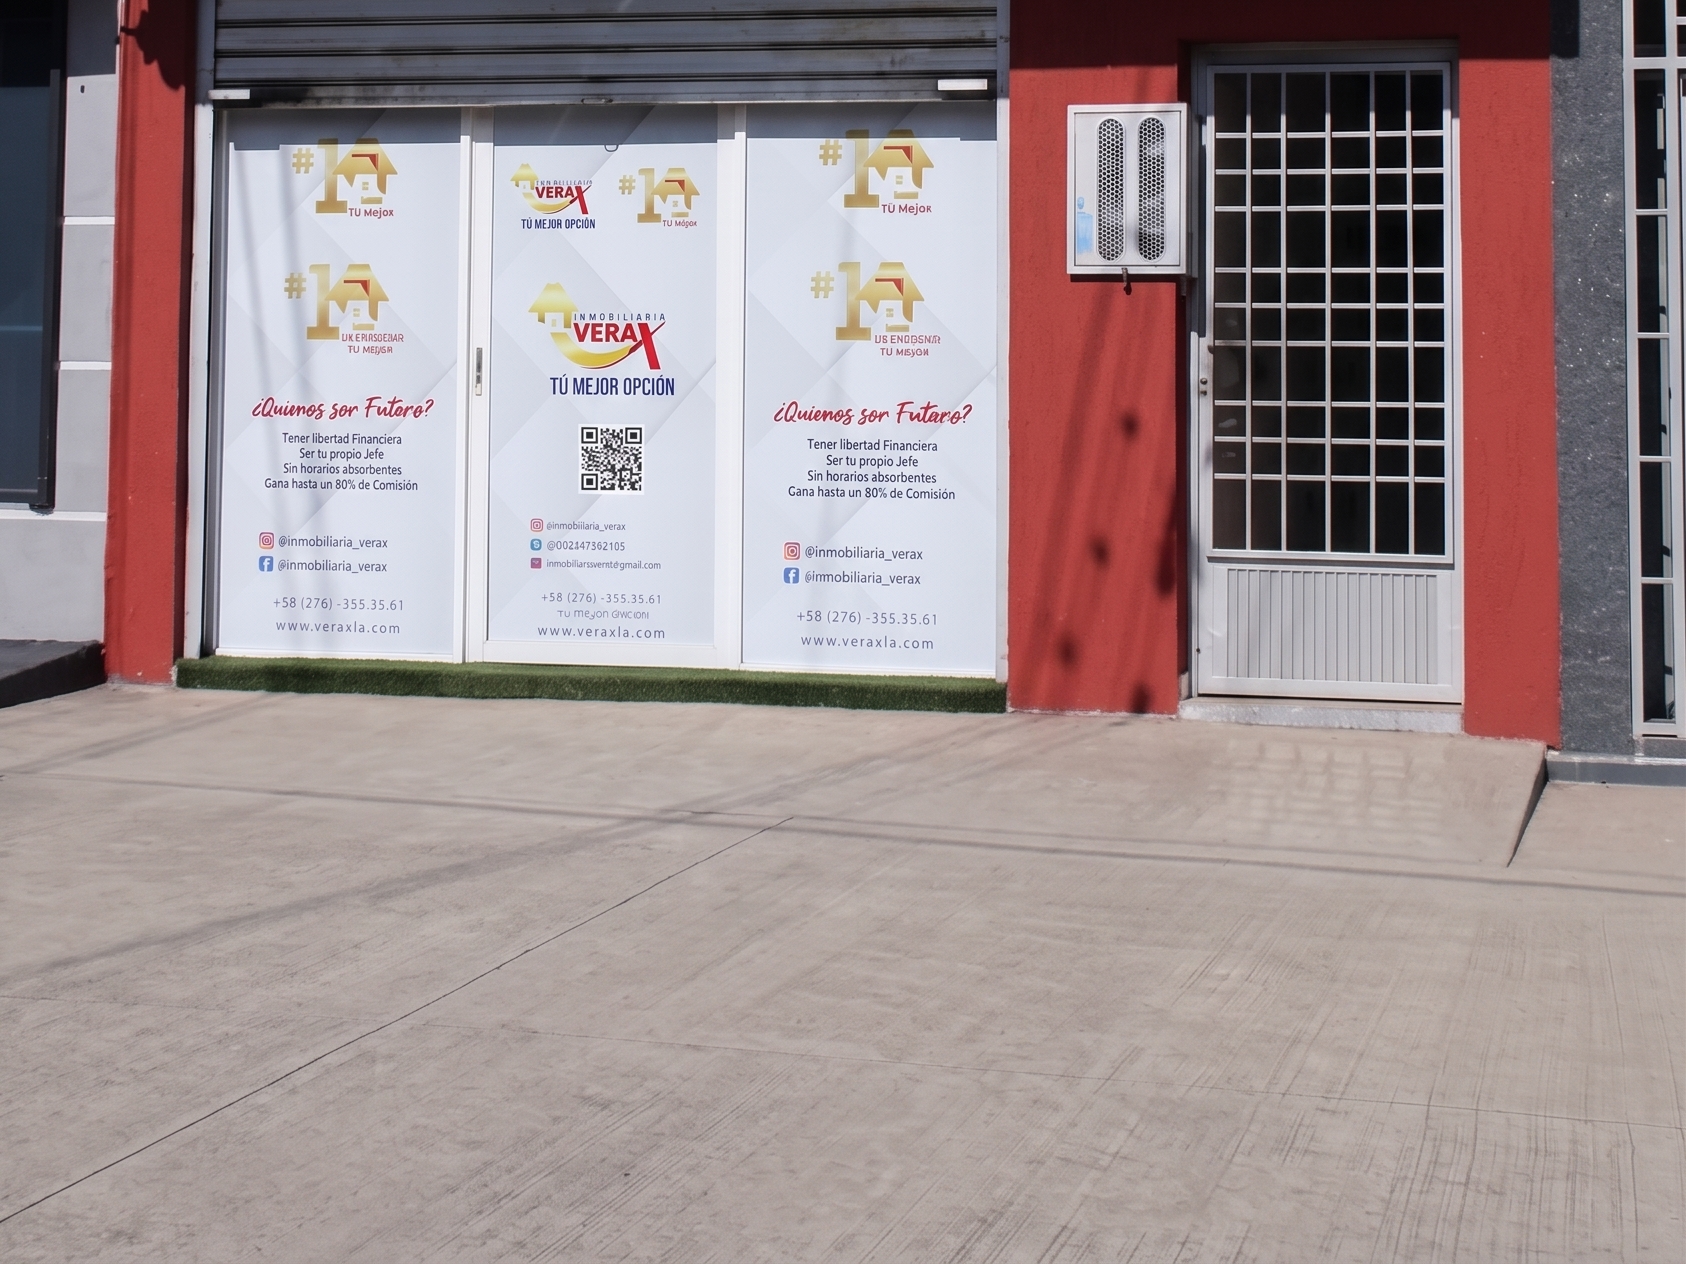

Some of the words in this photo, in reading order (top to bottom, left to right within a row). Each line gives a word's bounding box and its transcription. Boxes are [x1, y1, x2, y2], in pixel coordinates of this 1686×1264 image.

[535, 185, 592, 214] VERAX
[521, 217, 533, 229] TÚ
[535, 218, 562, 229] MEJOR
[565, 217, 596, 229] OPCIÓN
[574, 313, 666, 321] INMOBILIARIA
[573, 321, 666, 370] VERAX
[550, 374, 568, 395] TÚ
[573, 377, 618, 395] MEJOR
[623, 375, 675, 396] OPCIÓN
[282, 432, 310, 444] Tener
[312, 433, 349, 444] libertad
[352, 434, 402, 445] Financiera
[807, 439, 837, 450] Tener
[840, 439, 880, 451] libertad
[883, 440, 938, 451] Financiera
[299, 448, 315, 459] Ser
[317, 449, 327, 459] tu
[330, 449, 361, 461] propio
[364, 449, 384, 460] Jefe
[826, 455, 843, 465] Ser
[846, 456, 856, 465] tu
[860, 455, 893, 468] propio
[896, 456, 918, 467] Jefe
[283, 463, 298, 474] Sin
[300, 463, 340, 474] horarios
[342, 464, 402, 475] absorbentes
[807, 470, 823, 481] Sin
[826, 470, 868, 482] horarios
[871, 471, 936, 483] absorbentes
[264, 478, 289, 489] Gana
[292, 479, 318, 489] hasta
[320, 481, 333, 489] un
[335, 479, 356, 490] 80%
[358, 479, 370, 490] de
[373, 480, 418, 491] Comisión
[788, 487, 815, 497] Gana
[818, 487, 845, 497] hasta
[848, 489, 861, 498] un
[865, 488, 887, 498] 80%
[890, 488, 903, 498] de
[906, 488, 955, 499] Comisión
[278, 536, 388, 550] @inmobiliaria_verax
[805, 545, 923, 561] @inmobiliaria_verax
[278, 559, 387, 573] @inmobiliaria_verax
[273, 597, 297, 609] +58
[301, 597, 333, 610] (276)
[542, 593, 563, 602] +58
[568, 593, 597, 604] (276)
[797, 610, 822, 622] +58
[827, 610, 861, 624] (276)
[276, 621, 400, 633] www.veraxla.com
[538, 626, 665, 639] www.veraxla.com
[801, 636, 934, 649] www.veraxla.com
